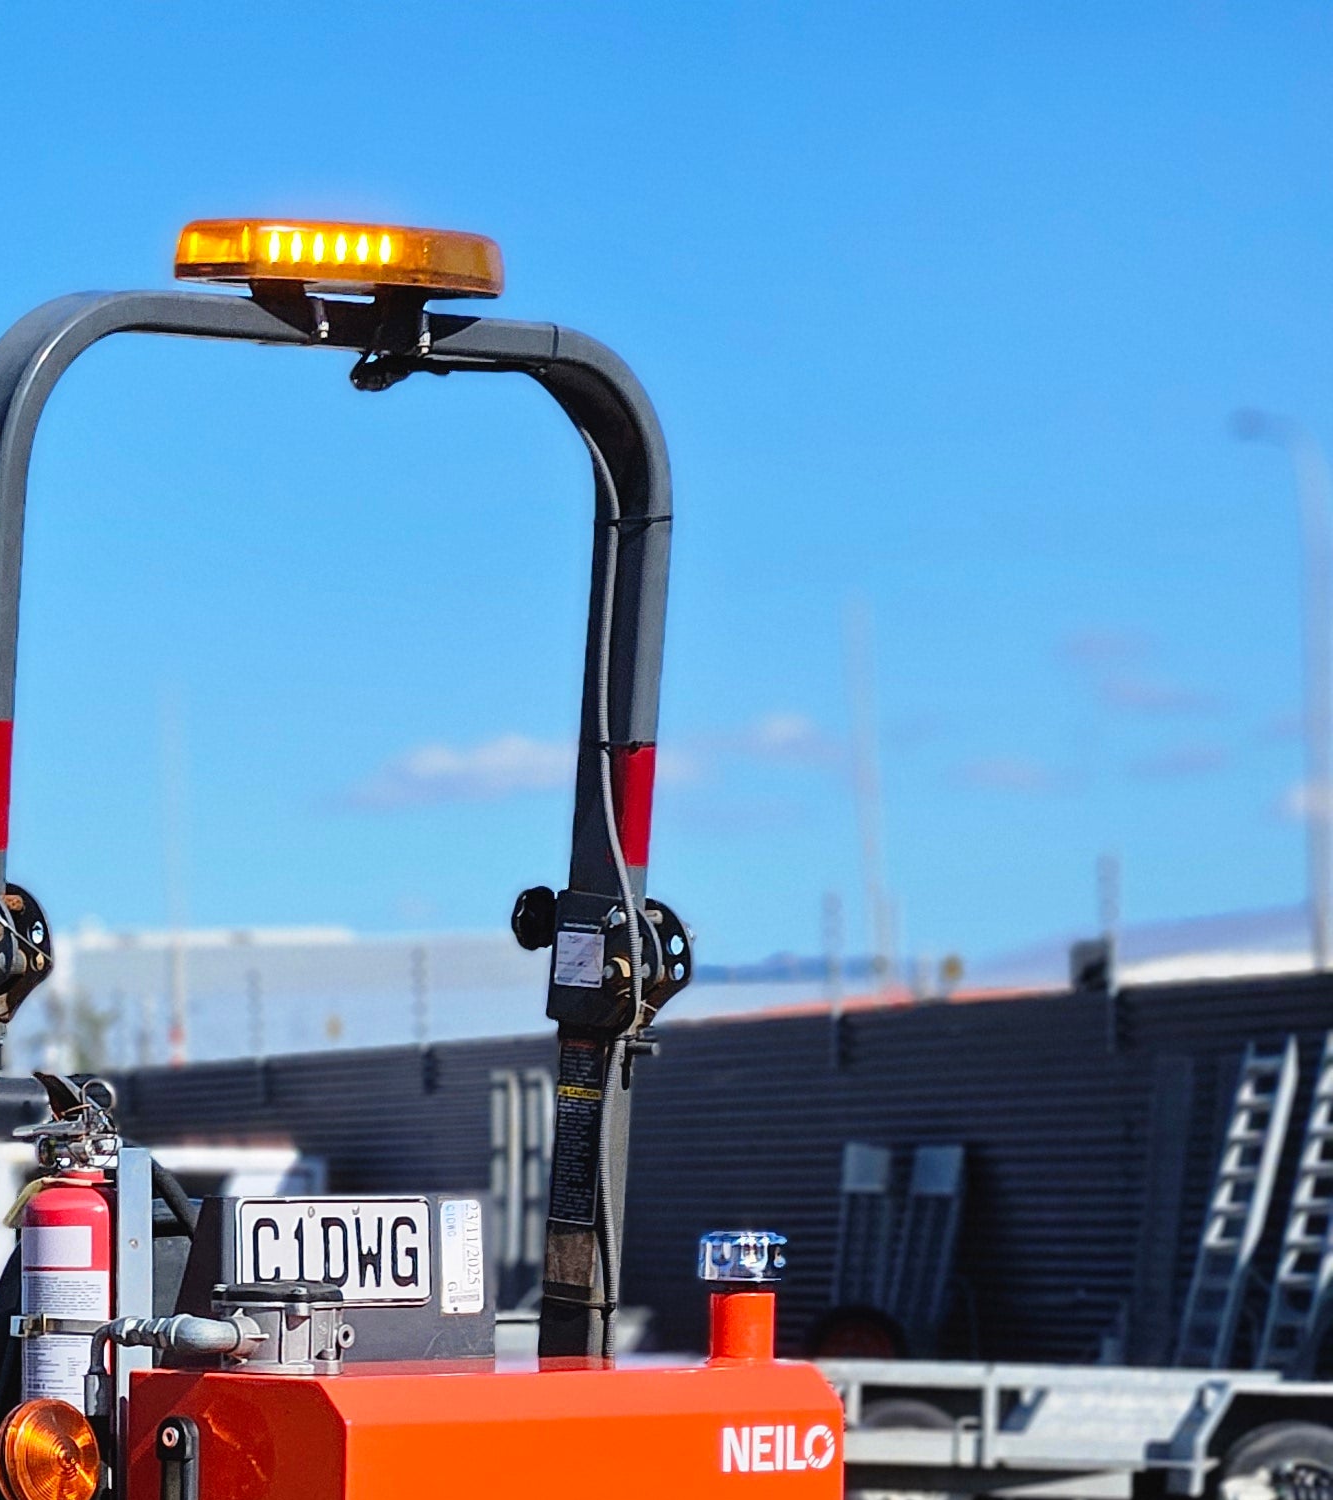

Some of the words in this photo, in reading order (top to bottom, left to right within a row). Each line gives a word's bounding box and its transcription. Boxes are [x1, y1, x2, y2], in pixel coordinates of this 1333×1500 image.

[252, 1216, 419, 1287] C1DWG
[464, 1203, 480, 1285] 23/11/2025
[722, 1425, 835, 1472] NEILO
